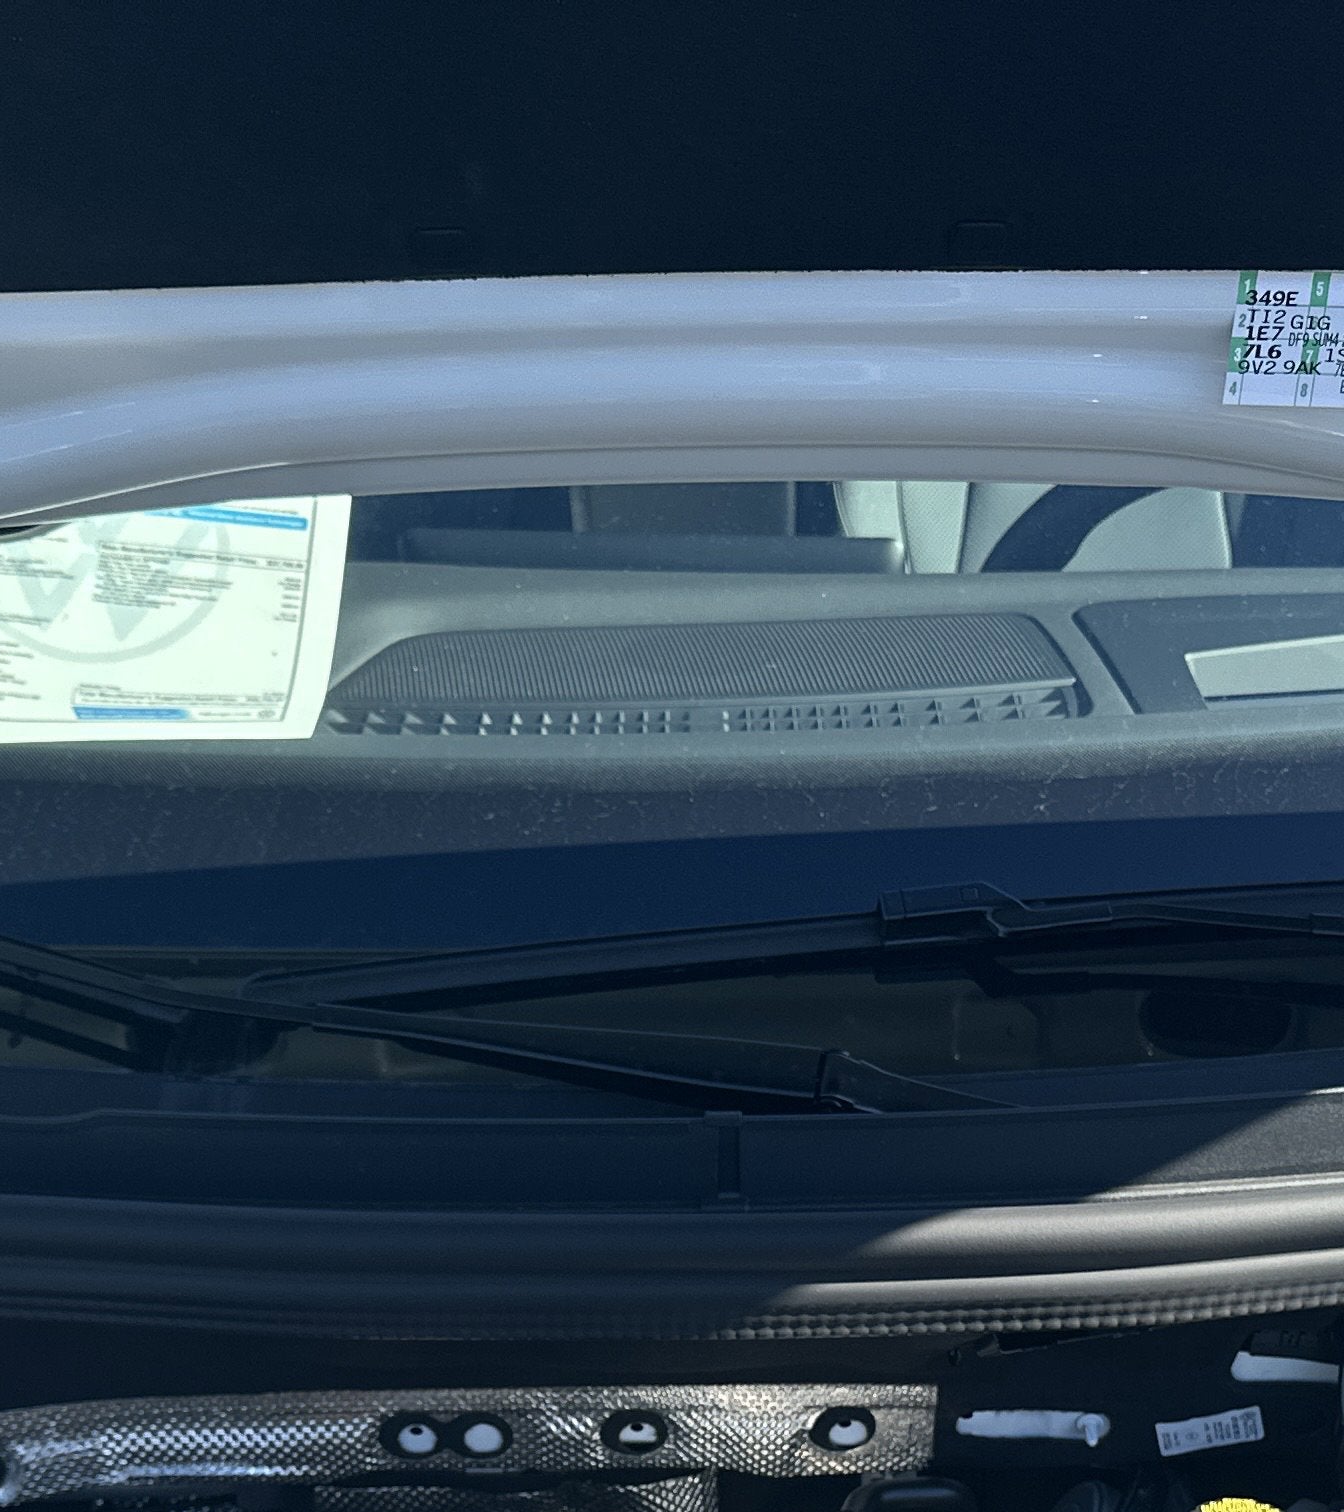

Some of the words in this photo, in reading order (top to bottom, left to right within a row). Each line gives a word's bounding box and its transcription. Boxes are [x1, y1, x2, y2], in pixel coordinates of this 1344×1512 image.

[1316, 281, 1325, 297] 5
[1245, 290, 1299, 306] 349E
[1238, 313, 1247, 328] 2
[1290, 314, 1331, 330] GIG
[1244, 325, 1285, 341] 1E7
[1234, 347, 1242, 362] 3
[1243, 344, 1282, 359] 7L6
[1306, 349, 1314, 363] 7
[1238, 360, 1276, 375] 9V2
[1283, 360, 1322, 376] 9AK
[1229, 381, 1237, 396] 4
[1300, 383, 1308, 398] 8
